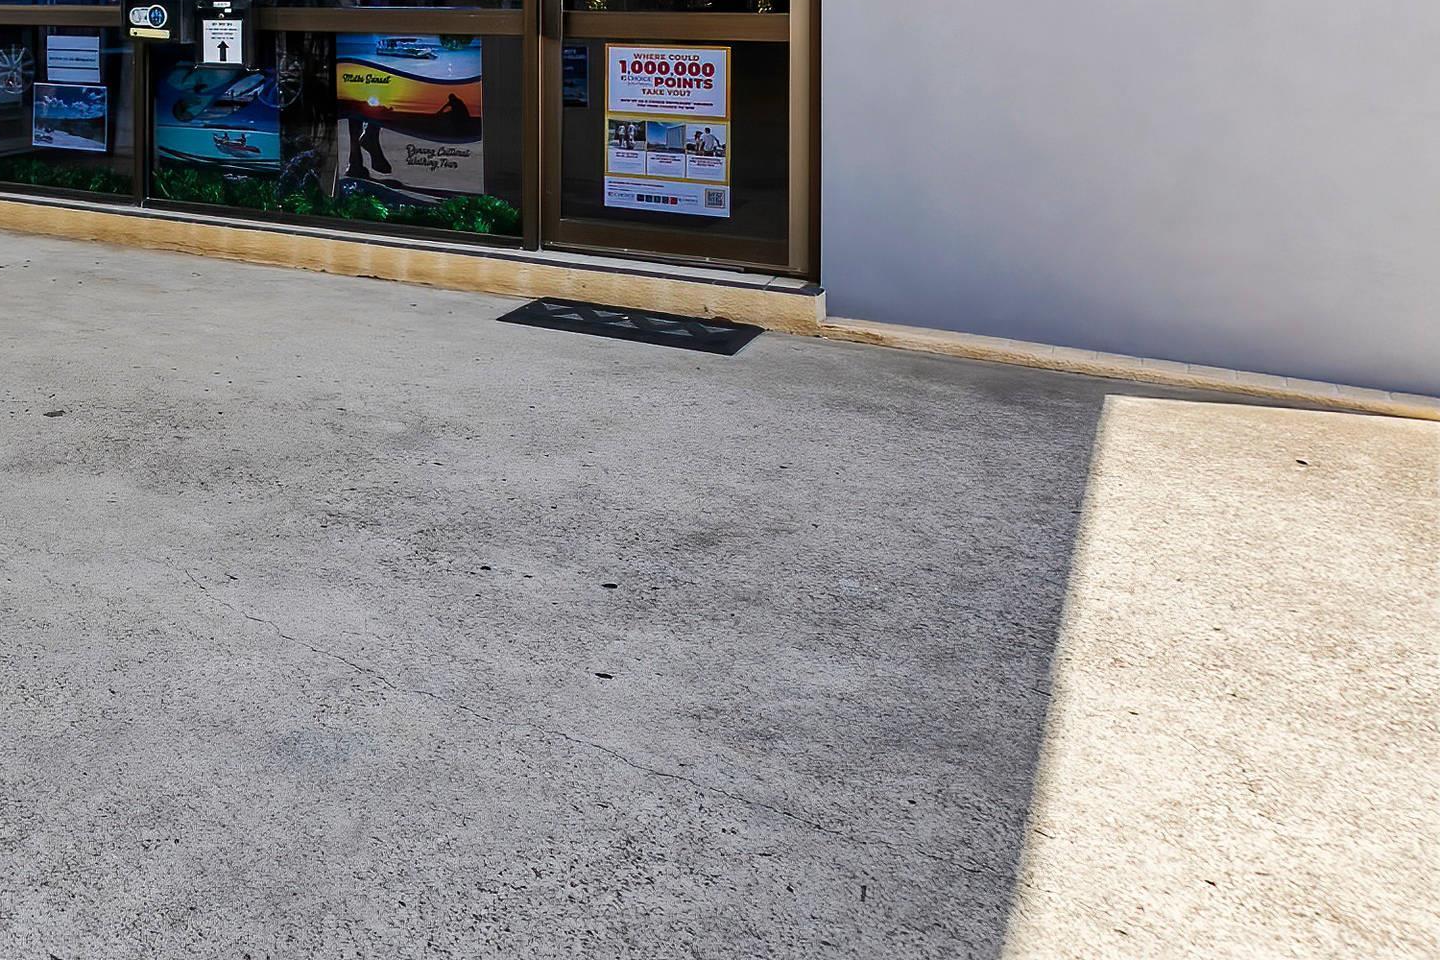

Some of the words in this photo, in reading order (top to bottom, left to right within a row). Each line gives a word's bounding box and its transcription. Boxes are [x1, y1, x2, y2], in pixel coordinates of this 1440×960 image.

[633, 53, 666, 61] WHERE
[668, 54, 700, 62] COULD
[619, 60, 715, 77] 1,000,000
[654, 76, 714, 90] POINTS
[641, 88, 665, 96] TAKE
[667, 89, 691, 97] YOU?
